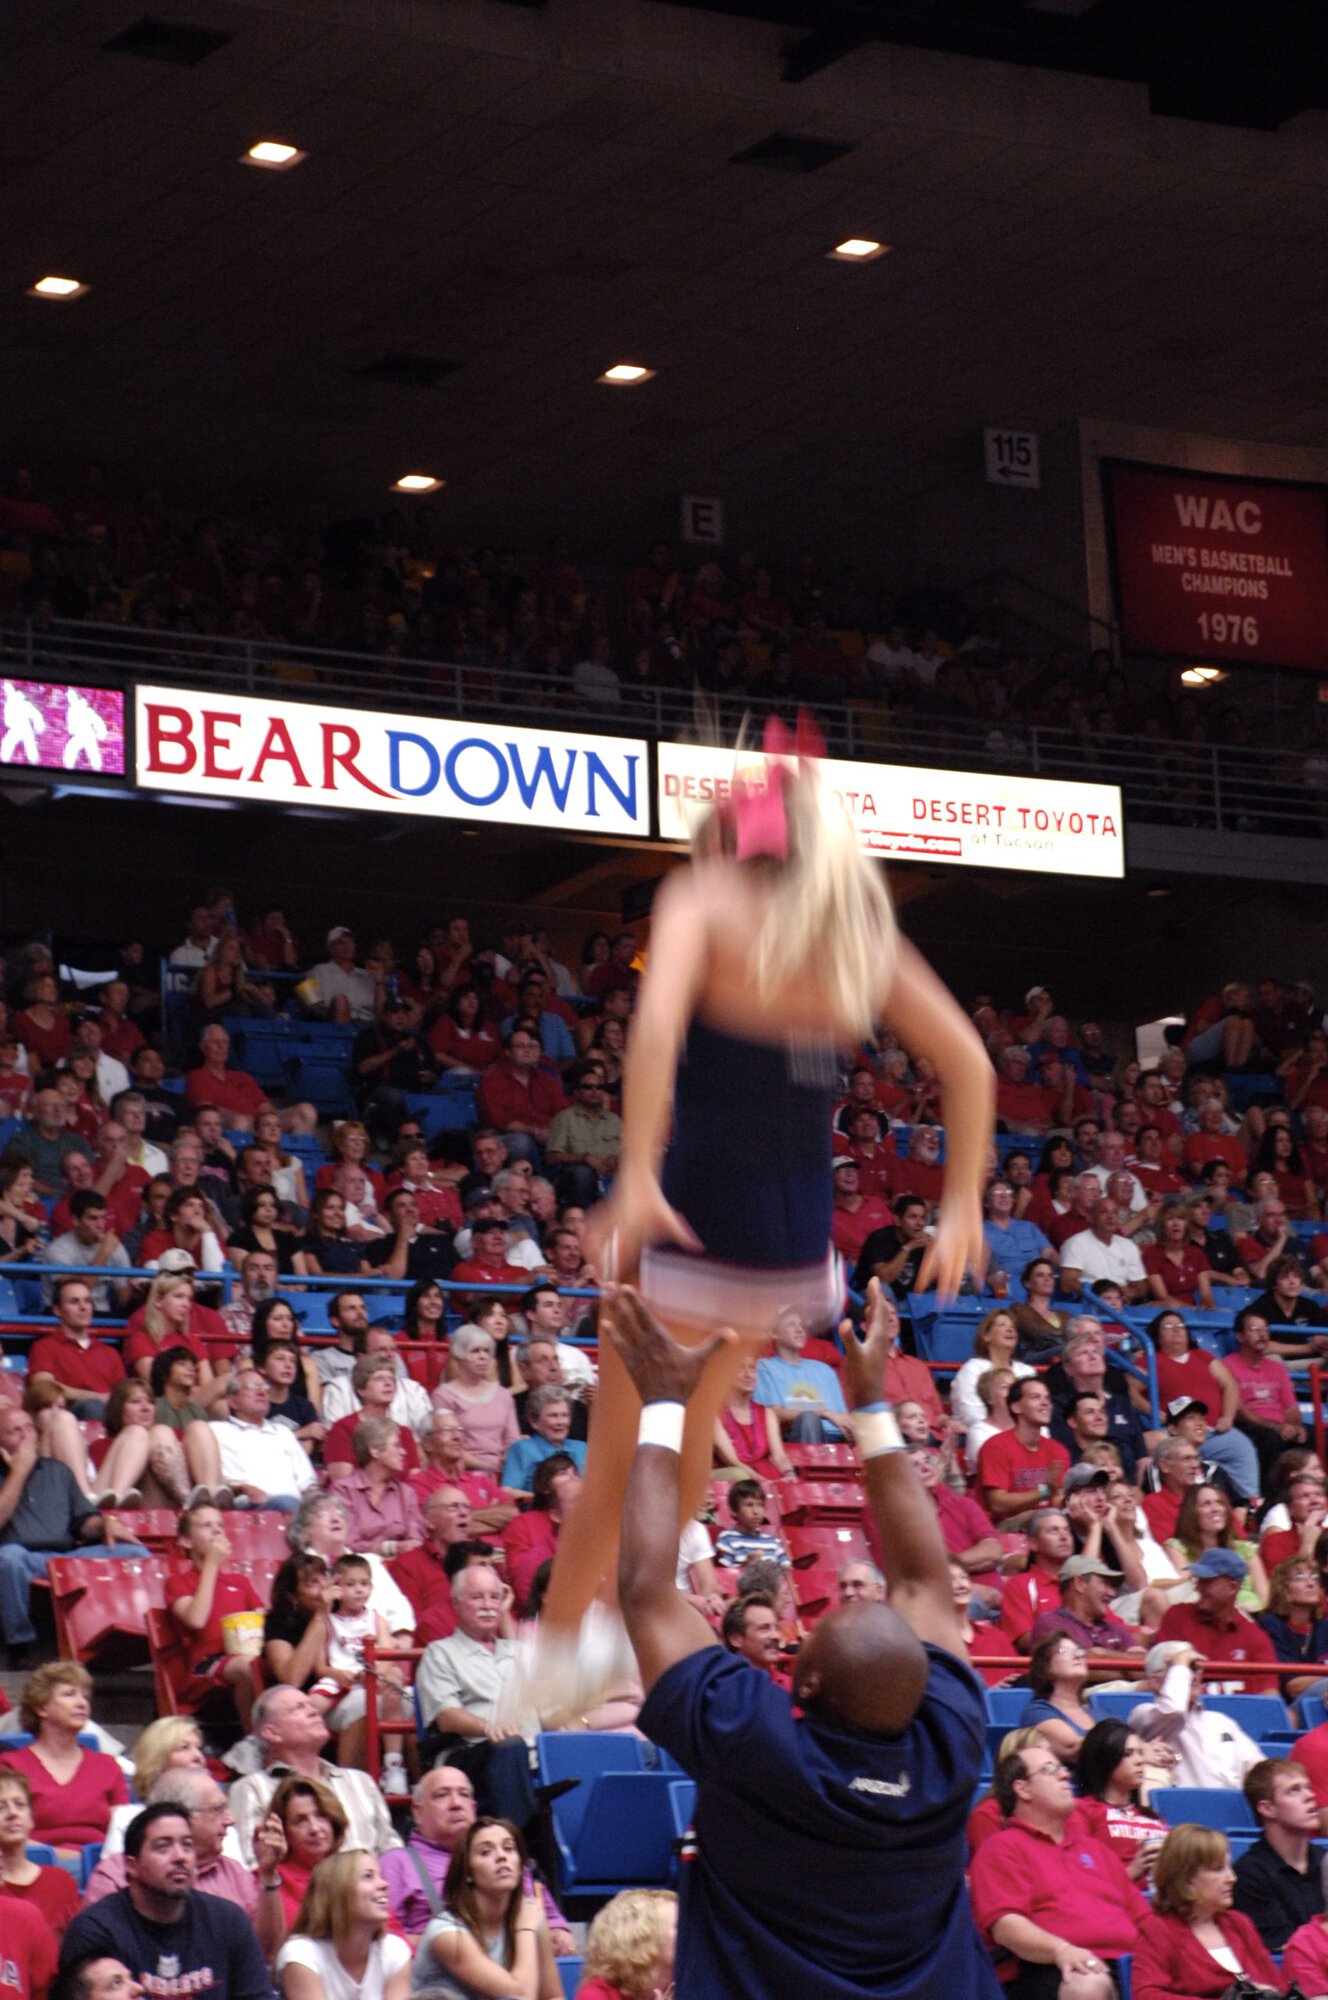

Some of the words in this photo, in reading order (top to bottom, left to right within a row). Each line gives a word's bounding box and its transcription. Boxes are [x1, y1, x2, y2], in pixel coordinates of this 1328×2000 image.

[992, 434, 1032, 466] 115
[691, 502, 715, 537] E
[1174, 494, 1263, 535] WAC
[1151, 544, 1197, 568] MEN'S
[1201, 549, 1294, 577] BASKETBALL
[1182, 572, 1268, 600] CHAMPIONS
[1198, 612, 1260, 646] 1976
[143, 703, 400, 799] BEAR
[385, 730, 640, 821] DOWN
[912, 798, 1007, 827] DESERT
[1017, 808, 1118, 837] TOYOTA
[971, 833, 987, 845] of
[994, 833, 1055, 851] Tucson
